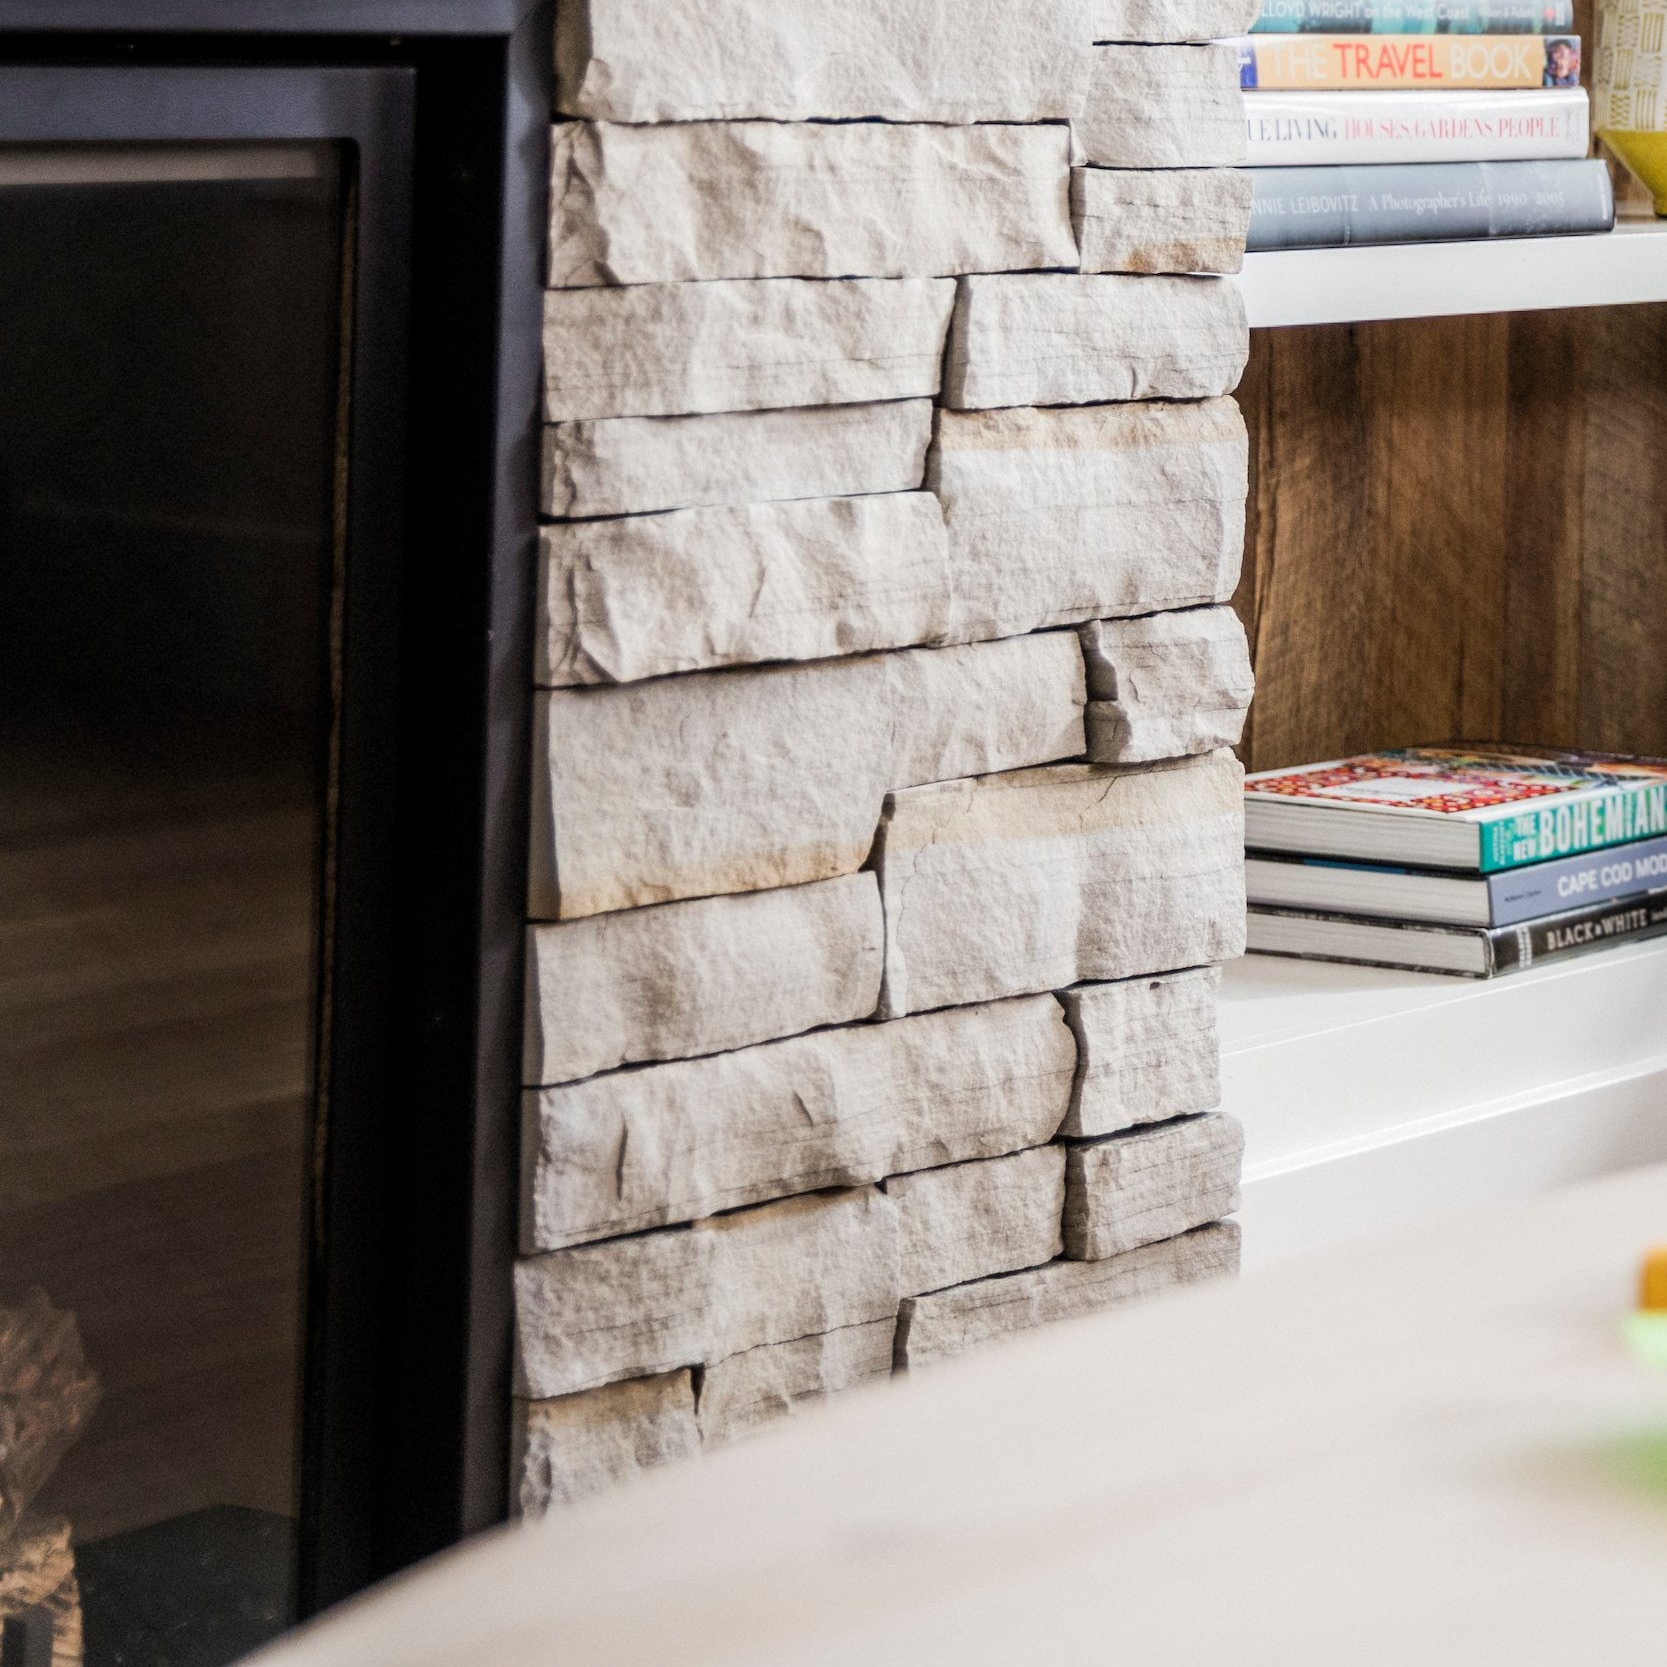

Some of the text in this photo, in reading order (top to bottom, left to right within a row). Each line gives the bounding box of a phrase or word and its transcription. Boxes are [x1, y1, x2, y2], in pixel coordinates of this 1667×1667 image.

[1261, 0, 1305, 18] LLOYD
[1309, 0, 1361, 19] WRIGHT
[1364, 6, 1379, 18] on
[1383, 2, 1402, 18] the
[1405, 2, 1433, 19] West
[1437, 2, 1470, 20] Coast
[1272, 42, 1328, 80] THE
[1332, 42, 1443, 80] TRAVEL
[1450, 42, 1533, 80] BOOK
[1276, 117, 1338, 142] LIVING
[1498, 116, 1560, 139] PEOPLE
[1252, 197, 1286, 215] NNIE
[1290, 194, 1359, 215] LEIBOVITZ
[1368, 195, 1380, 212] A
[1468, 189, 1490, 208] Life
[1497, 192, 1528, 207] 1990
[1515, 814, 1536, 837] THE
[1513, 839, 1536, 862] NEW
[1557, 869, 1599, 898] CAPE
[1600, 862, 1633, 888] COD
[1546, 921, 1595, 951] BLACK
[1601, 908, 1648, 935] WHITE
